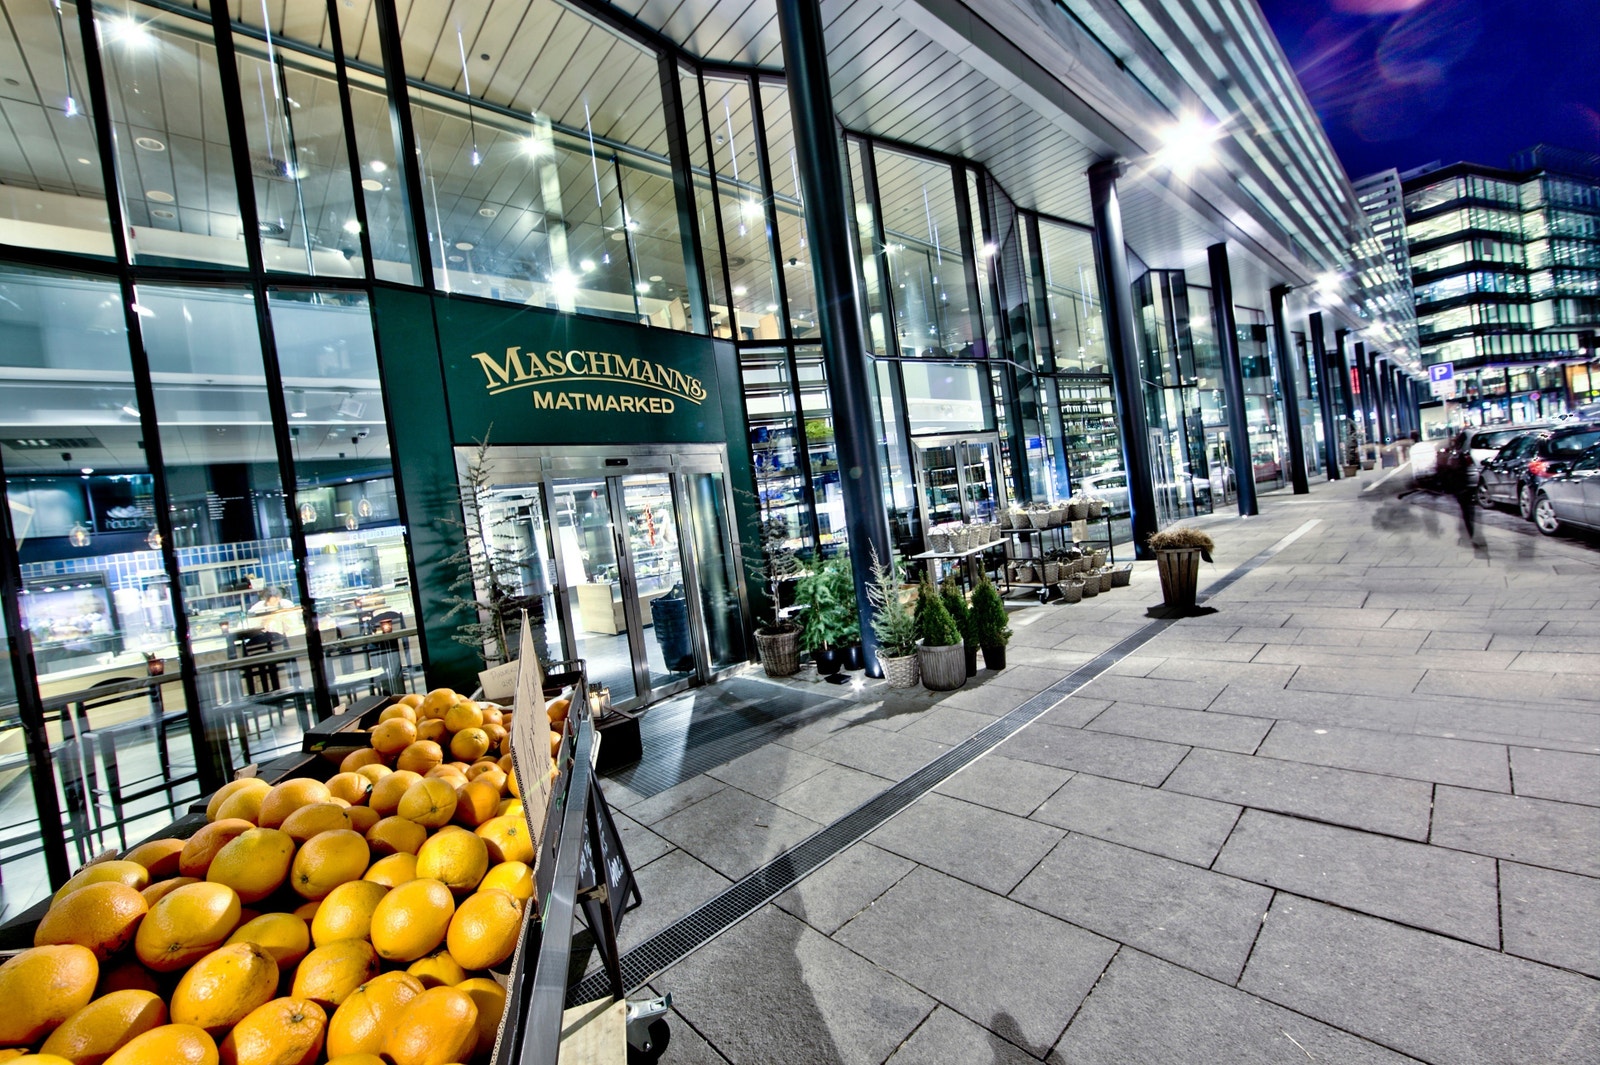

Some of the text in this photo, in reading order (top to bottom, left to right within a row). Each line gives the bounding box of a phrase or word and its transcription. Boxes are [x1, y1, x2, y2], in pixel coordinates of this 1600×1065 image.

[472, 346, 707, 400] MASCHMANNS
[1434, 366, 1448, 380] P
[533, 391, 675, 414] MATMARKED
